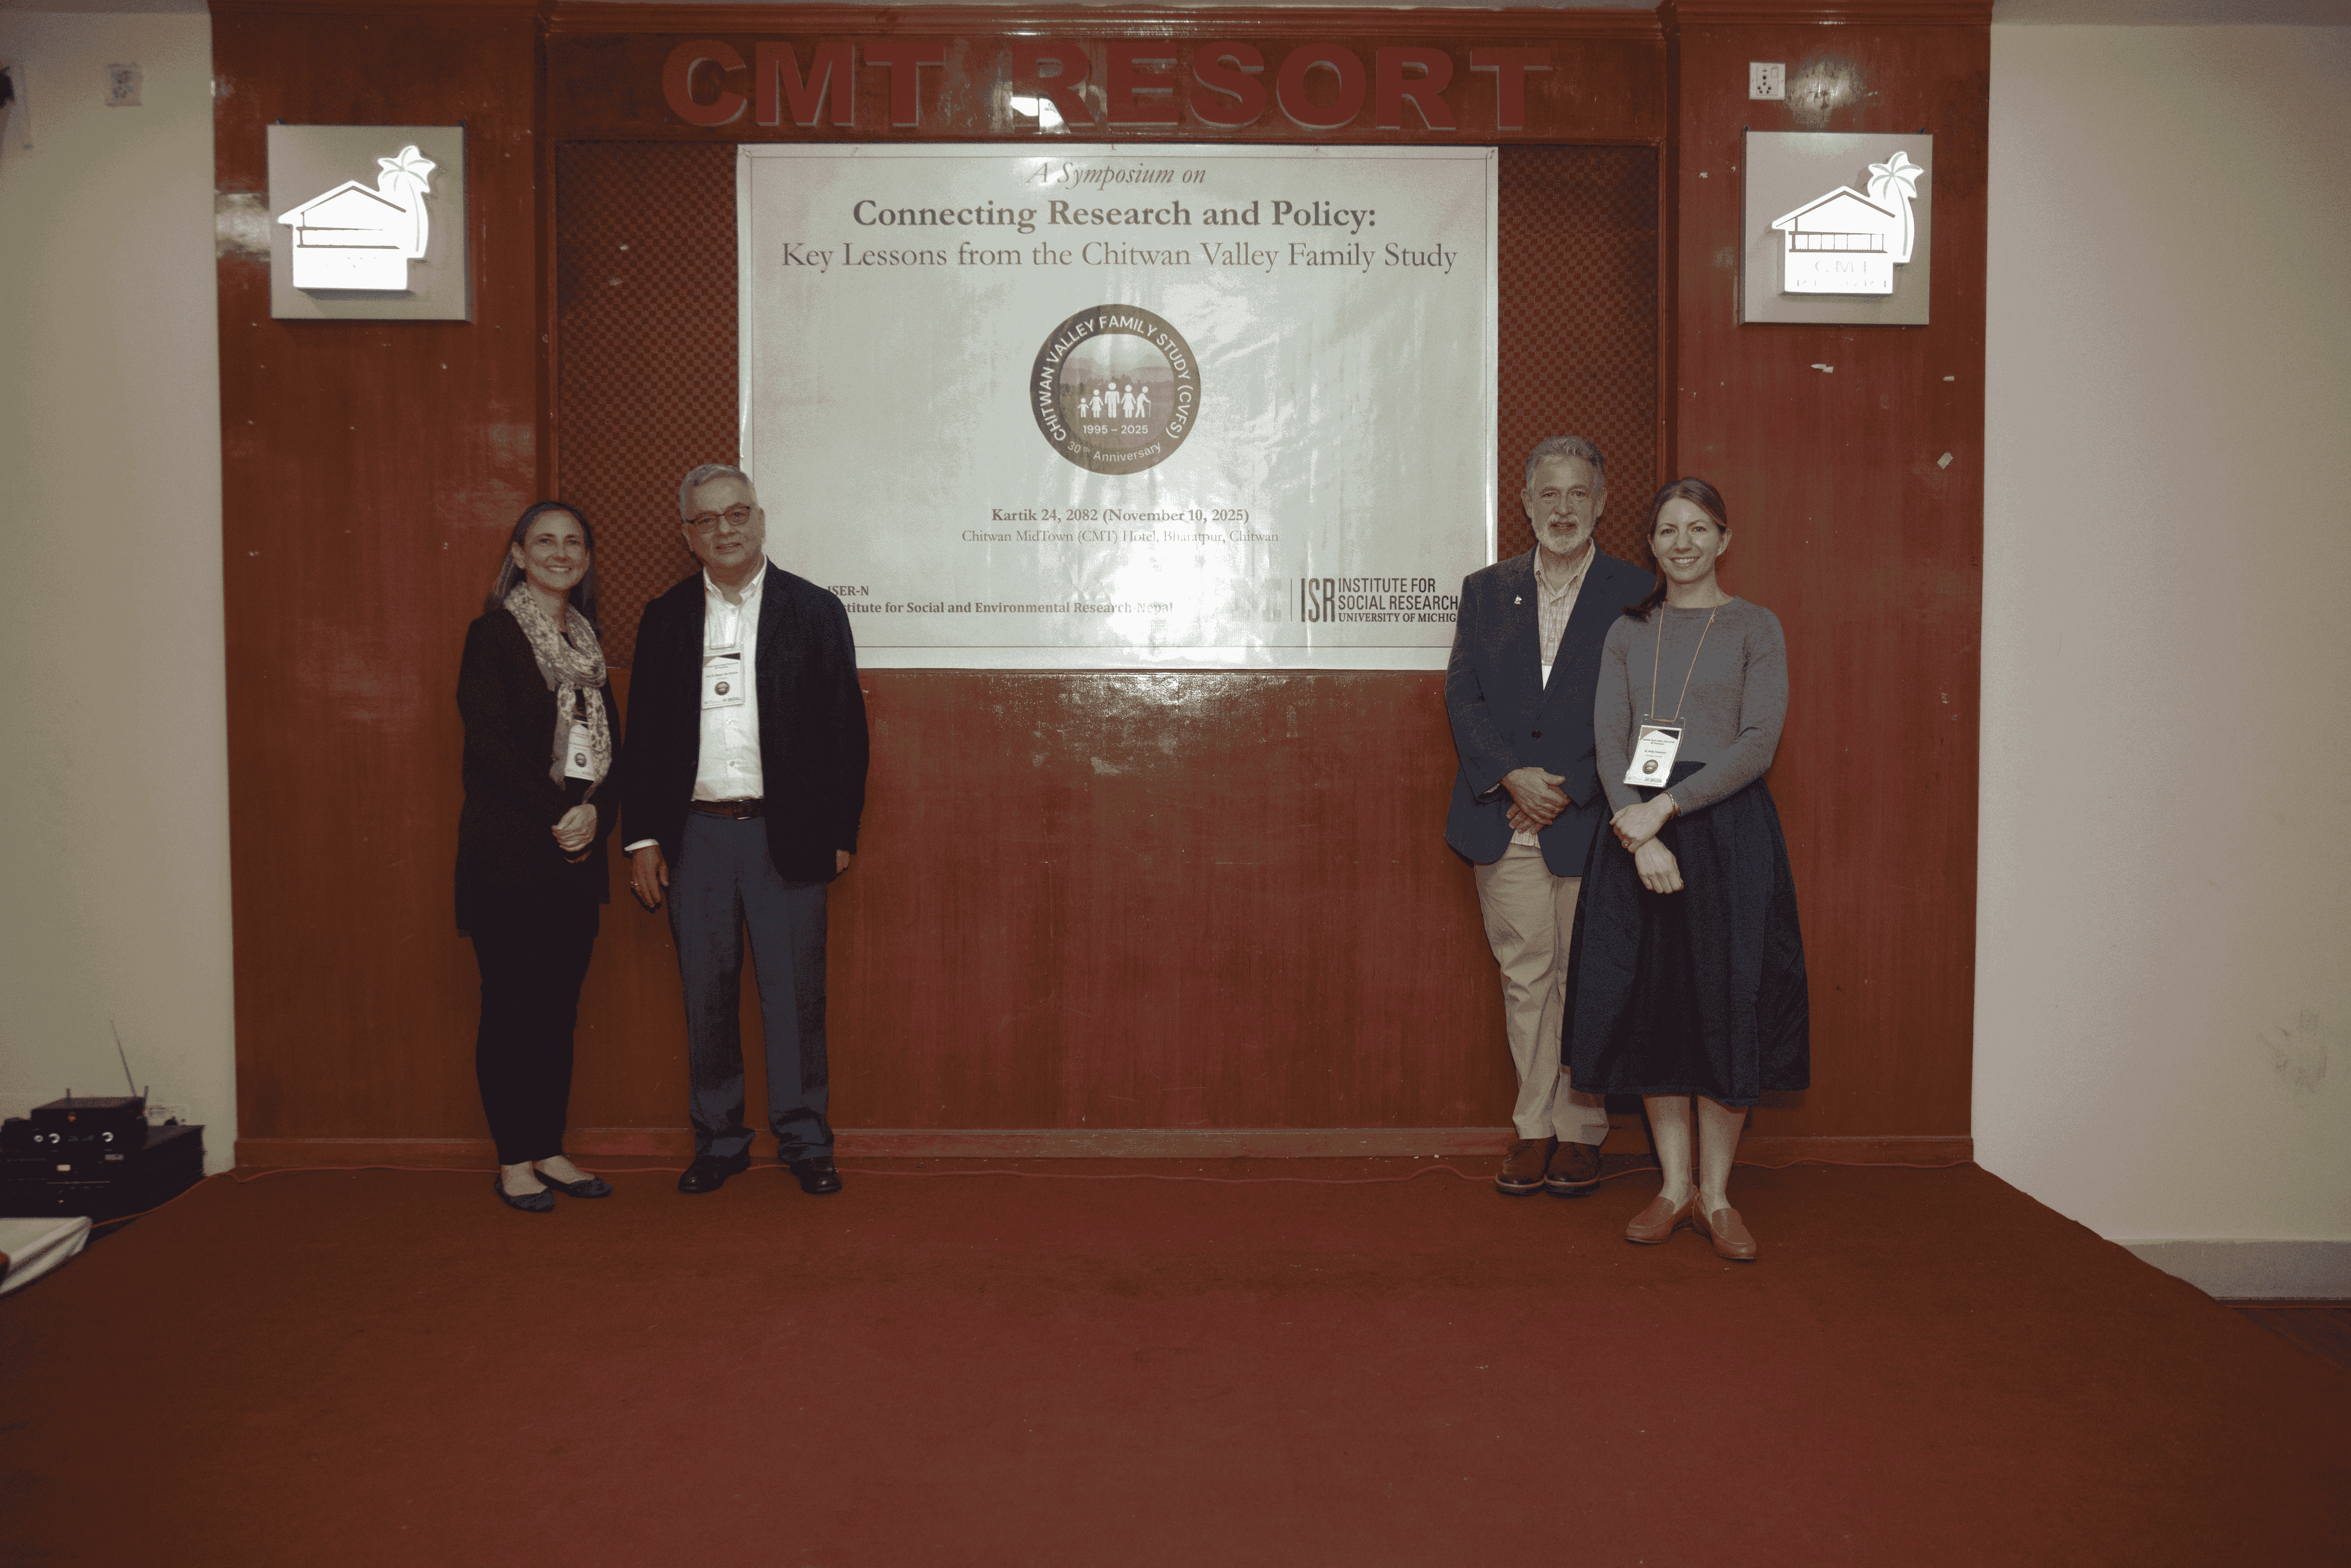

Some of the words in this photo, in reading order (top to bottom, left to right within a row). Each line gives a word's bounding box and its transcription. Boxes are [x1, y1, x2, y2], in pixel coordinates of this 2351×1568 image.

[661, 39, 945, 127] CMT
[1011, 41, 1552, 132] RESORT
[1026, 162, 1051, 183] A
[1057, 162, 1174, 190] Symposium
[1182, 170, 1205, 183] on
[853, 200, 1037, 234] Connecting
[1049, 200, 1192, 225] Research
[1203, 200, 1259, 225] and
[1272, 200, 1375, 234] Policy:
[783, 243, 832, 273] Key
[844, 243, 947, 266] Lessons
[958, 241, 1021, 265] from
[1032, 242, 1072, 265] the
[1082, 242, 1191, 265] Chitwan
[1200, 242, 1278, 273] Valley
[1289, 242, 1374, 273] Family
[1385, 243, 1457, 274] Study
[1099, 316, 1157, 337] FAMILY
[1046, 319, 1094, 363] VALLEY
[1157, 333, 1191, 379] STUDY
[1039, 366, 1067, 441] CHITWAN
[1166, 385, 1194, 439] (CVFS)
[1083, 425, 1108, 434] 1995
[1121, 425, 1149, 434] 2025
[1093, 442, 1161, 462] Anniversary
[992, 509, 1037, 521] Kartik
[1041, 509, 1062, 523] 24,
[1066, 509, 1098, 521] 2082
[1103, 508, 1185, 523] (November
[1189, 509, 1207, 523] 10,
[1212, 509, 1249, 524] 2025)
[962, 530, 1012, 541] Chitwan
[1016, 530, 1073, 541] MidTown
[1078, 530, 1118, 543] (CMT)
[1123, 530, 1159, 544] Hotel,
[1164, 530, 1226, 545] Bharatpur,
[1230, 529, 1279, 541] Chitwan
[1338, 577, 1408, 593] INSTITUTE
[1411, 577, 1436, 593] FOR
[844, 602, 882, 613] titute
[885, 602, 904, 613] for
[907, 602, 944, 613] Social
[948, 602, 971, 613] and
[975, 601, 1070, 613] Environmental
[1301, 577, 1336, 623] ISR
[1338, 595, 1386, 610] SOCIAL
[1390, 595, 1459, 610] RESEARCH
[1338, 613, 1400, 622] UNIVERSITY
[1403, 613, 1415, 622] OF
[1418, 613, 1456, 622] MICHIG
